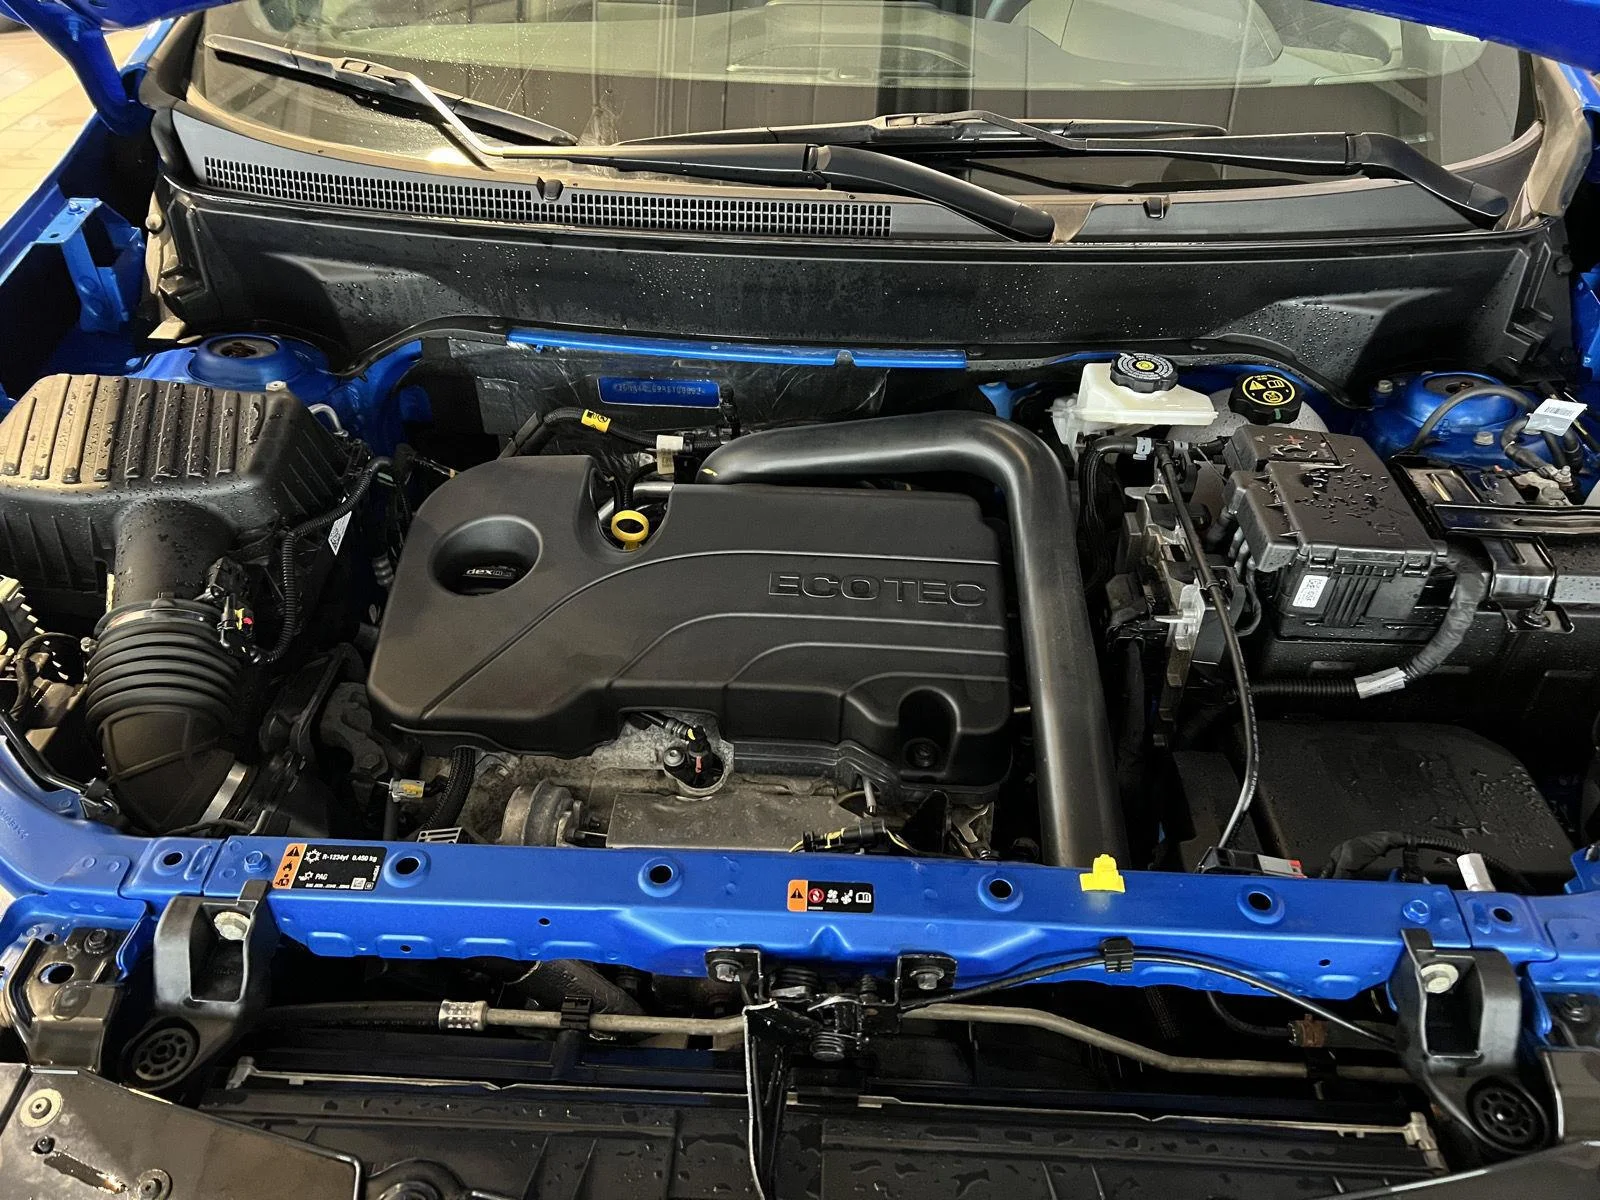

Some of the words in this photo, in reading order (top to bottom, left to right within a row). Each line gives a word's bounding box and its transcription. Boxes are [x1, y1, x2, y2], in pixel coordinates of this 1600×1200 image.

[768, 571, 987, 607] ECOTEC
[322, 853, 349, 862] R-1234yf
[314, 873, 328, 881] PAG
